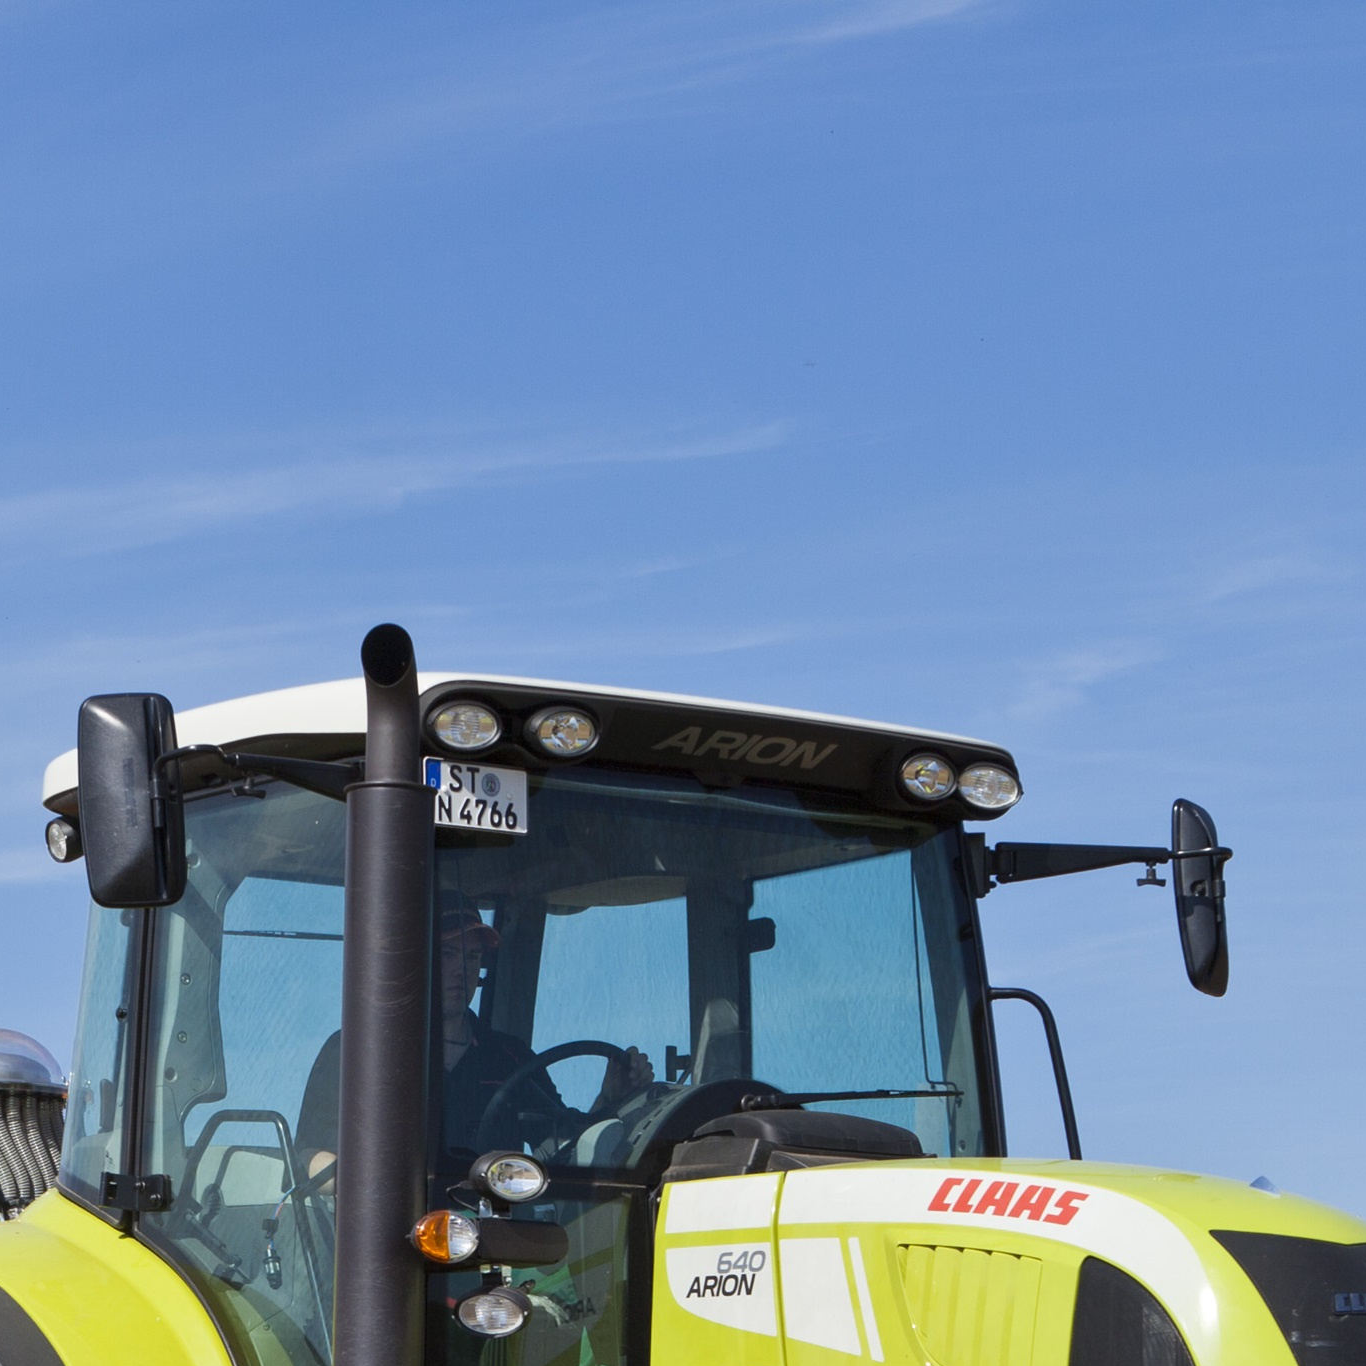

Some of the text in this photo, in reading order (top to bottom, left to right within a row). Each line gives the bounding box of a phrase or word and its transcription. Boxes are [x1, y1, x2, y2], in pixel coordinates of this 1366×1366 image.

[652, 725, 838, 770] ARION
[449, 764, 480, 794] ST
[437, 794, 518, 830] N 4766
[927, 1177, 1090, 1226] CLAAS
[716, 1250, 766, 1273] 640
[686, 1274, 757, 1299] ARION
